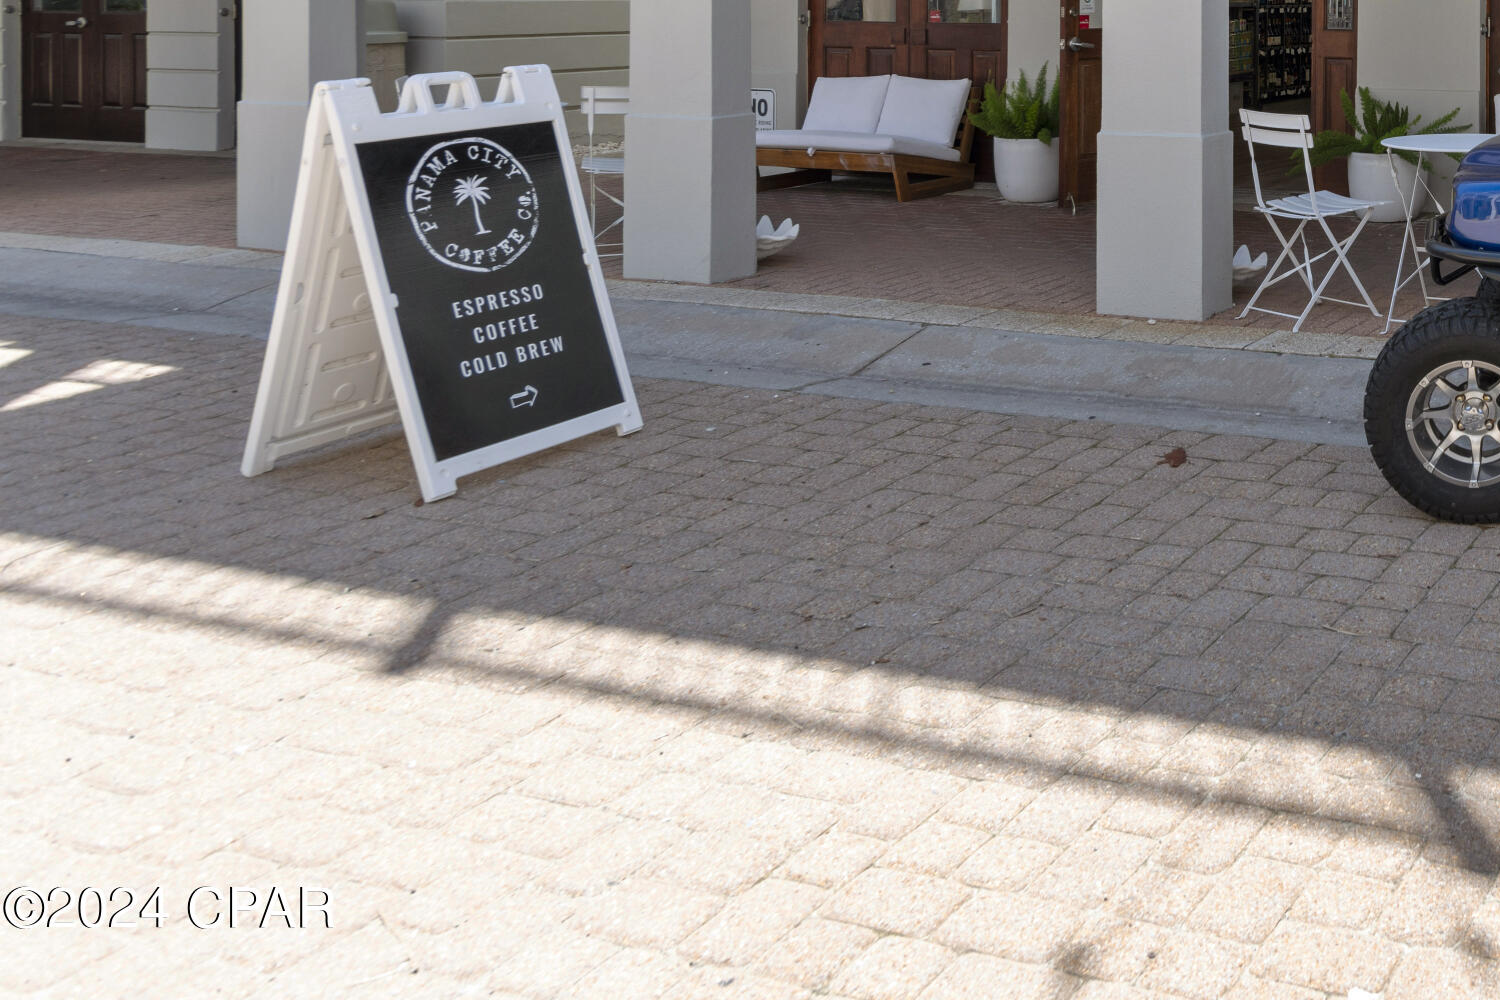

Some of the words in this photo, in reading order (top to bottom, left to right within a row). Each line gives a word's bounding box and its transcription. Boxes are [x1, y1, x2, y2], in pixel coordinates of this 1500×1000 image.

[414, 148, 459, 234] PANAMA
[466, 145, 522, 180] CITY
[444, 227, 526, 266] COFFEE
[451, 284, 544, 319] ESPRESSO
[472, 313, 540, 344] COFFEE
[459, 350, 509, 379] COLD
[515, 335, 565, 364] BREW
